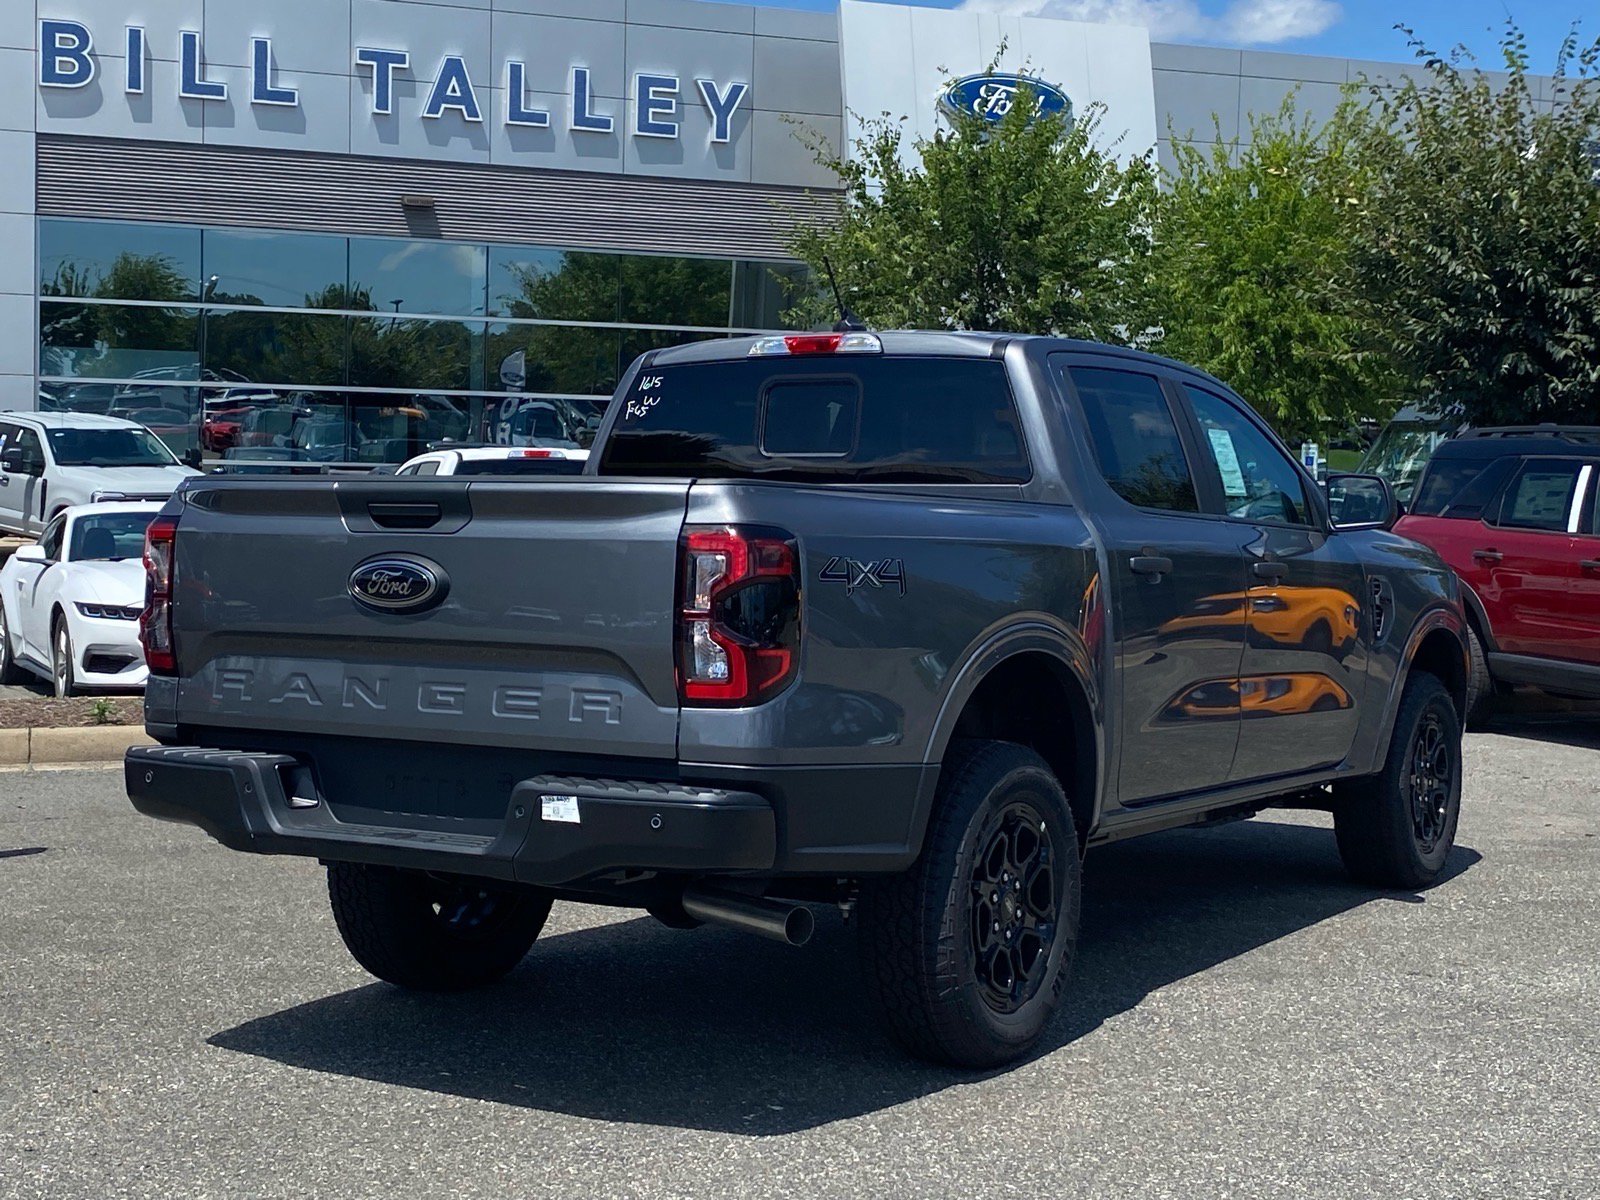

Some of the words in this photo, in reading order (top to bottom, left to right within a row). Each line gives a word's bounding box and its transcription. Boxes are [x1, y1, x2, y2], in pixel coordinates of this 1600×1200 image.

[39, 19, 299, 107] BILL
[355, 47, 750, 143] TALLEY
[973, 83, 1045, 117] Fod
[367, 569, 413, 595] Ford
[211, 668, 624, 725] RANGER
